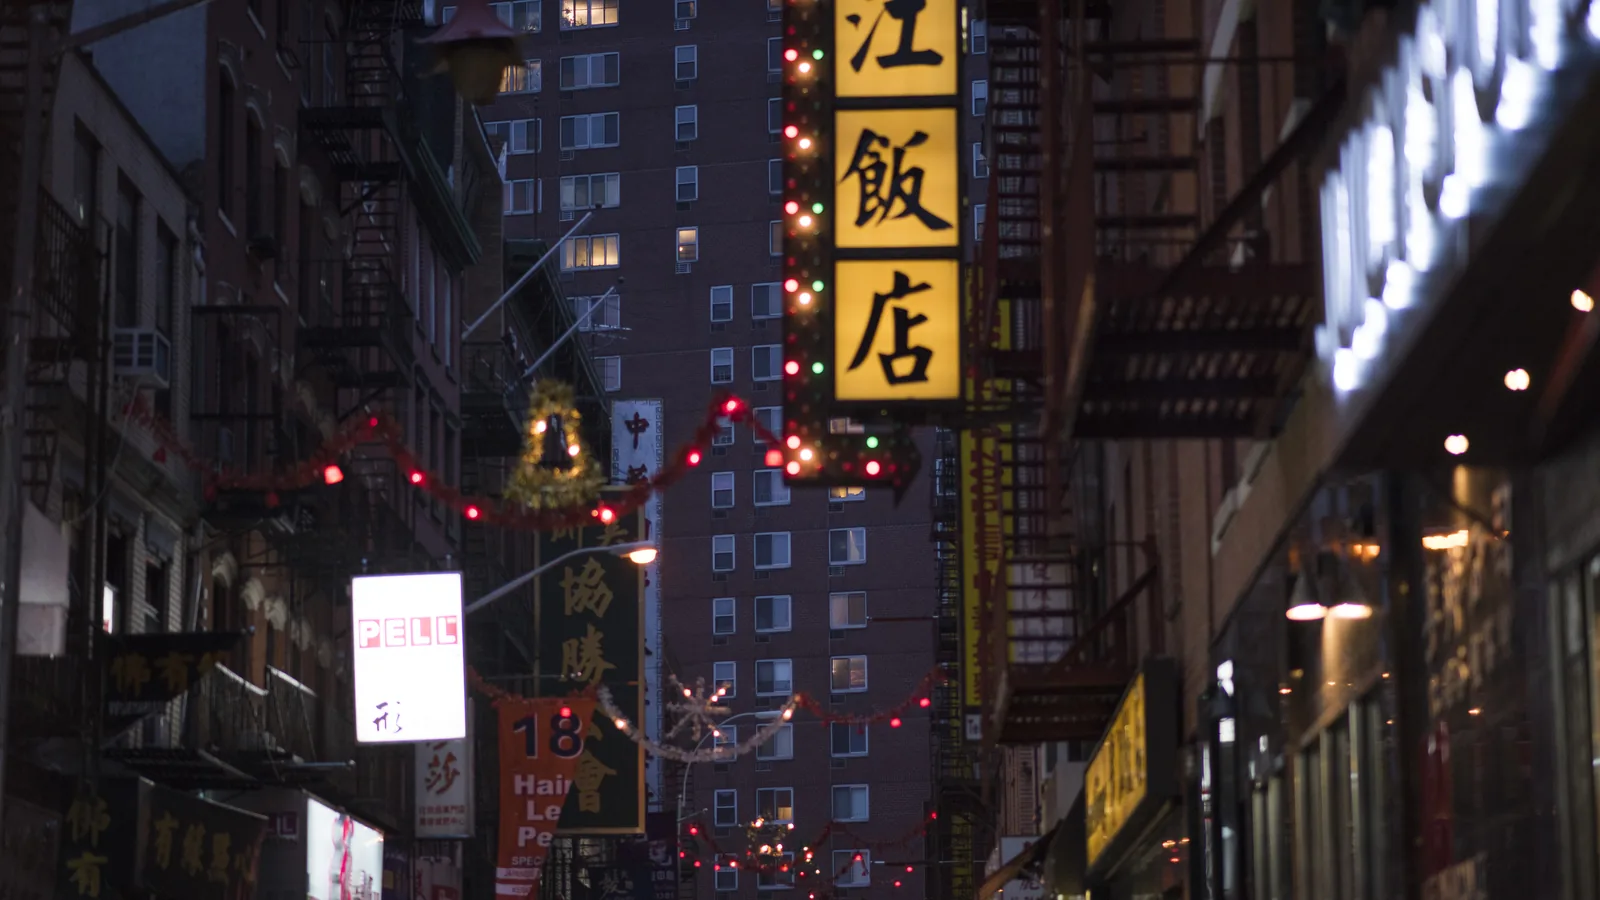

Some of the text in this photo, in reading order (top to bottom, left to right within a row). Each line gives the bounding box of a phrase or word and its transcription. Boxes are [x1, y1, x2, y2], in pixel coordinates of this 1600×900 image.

[839, 0, 953, 386] 江飯店
[358, 615, 458, 649] PELL
[513, 711, 585, 760] 18
